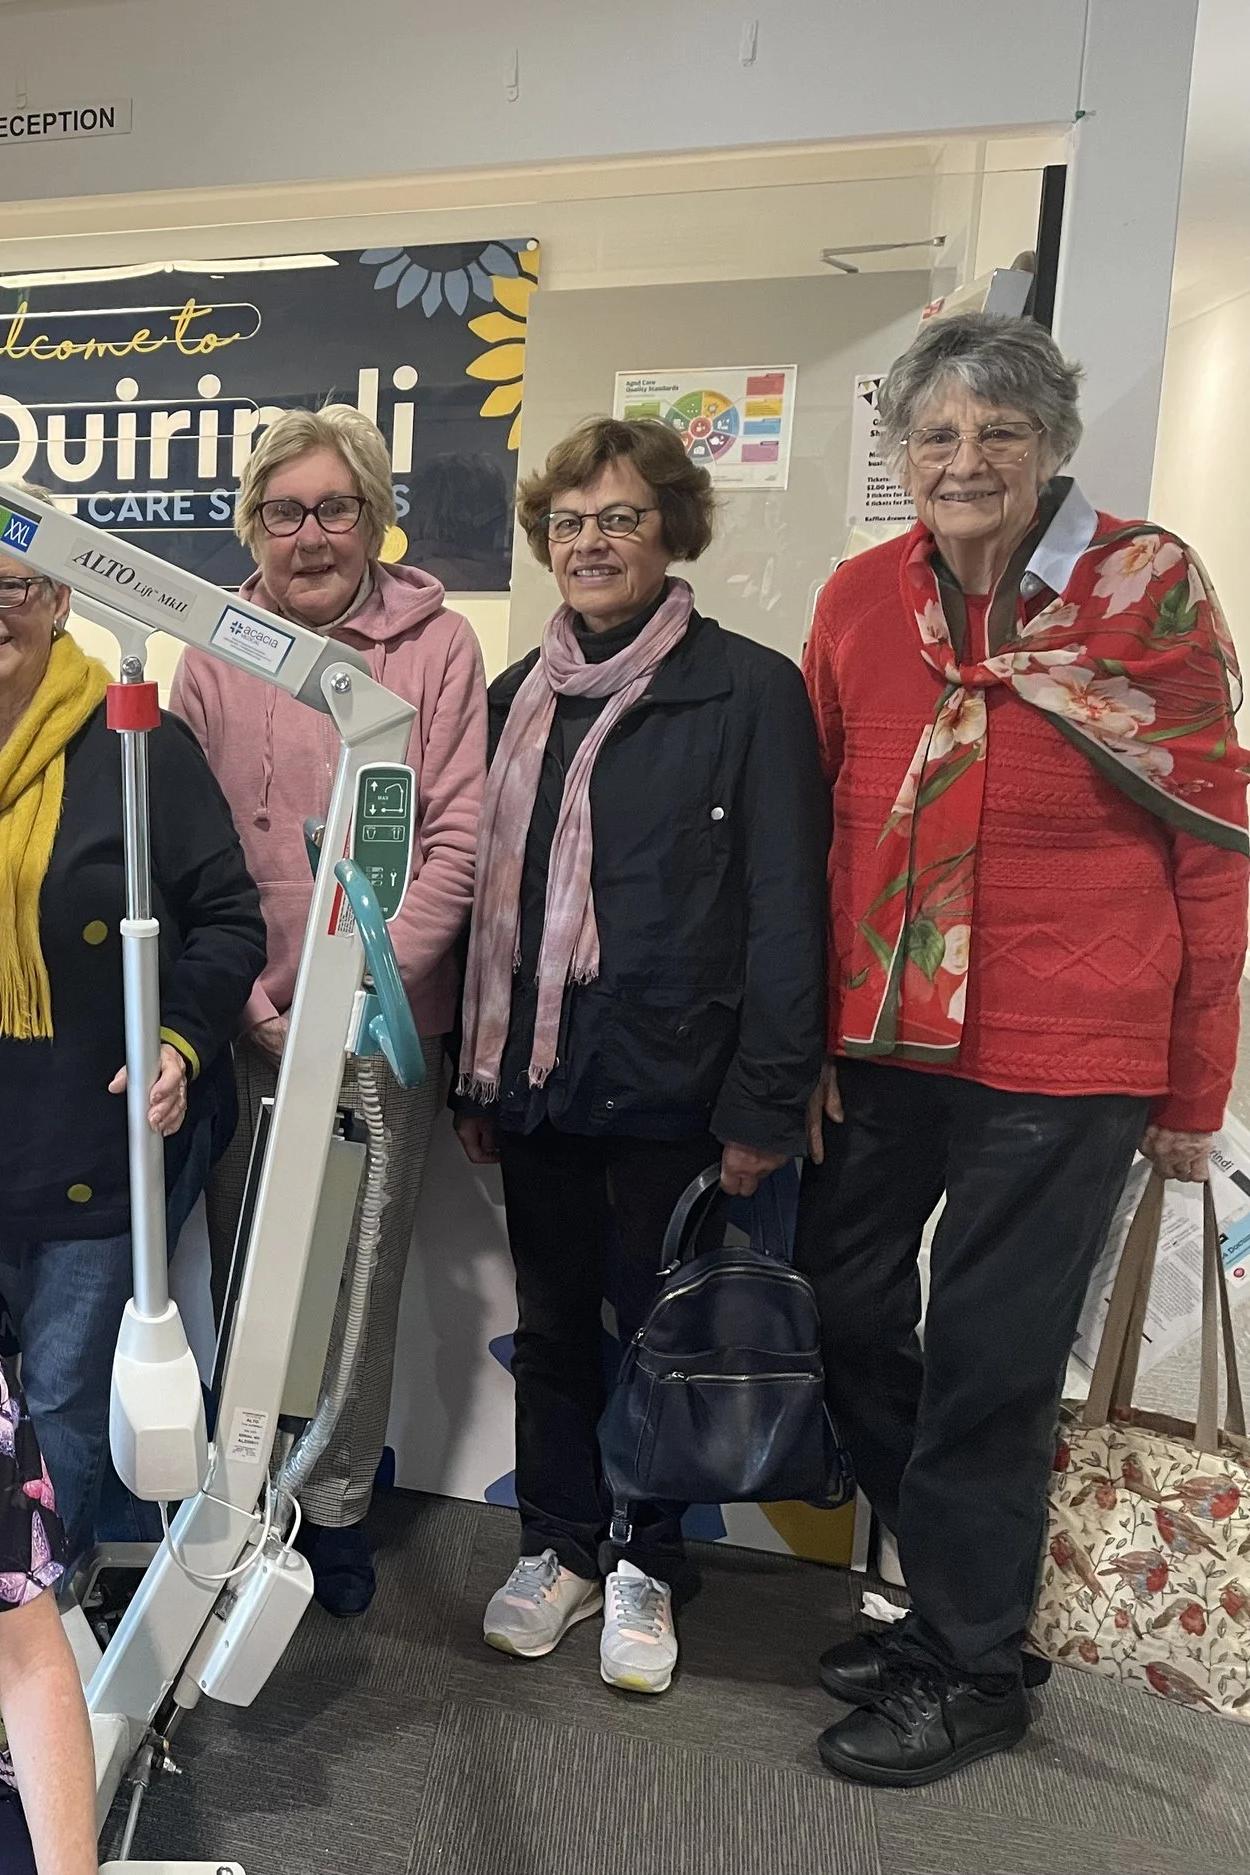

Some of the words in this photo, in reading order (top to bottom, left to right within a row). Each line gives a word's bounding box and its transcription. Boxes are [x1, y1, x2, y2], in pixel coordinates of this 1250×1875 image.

[169, 298, 240, 355] to
[87, 489, 195, 522] CARE
[4, 518, 30, 547] XXL
[73, 549, 136, 585] ALTO
[243, 626, 279, 649] acacia
